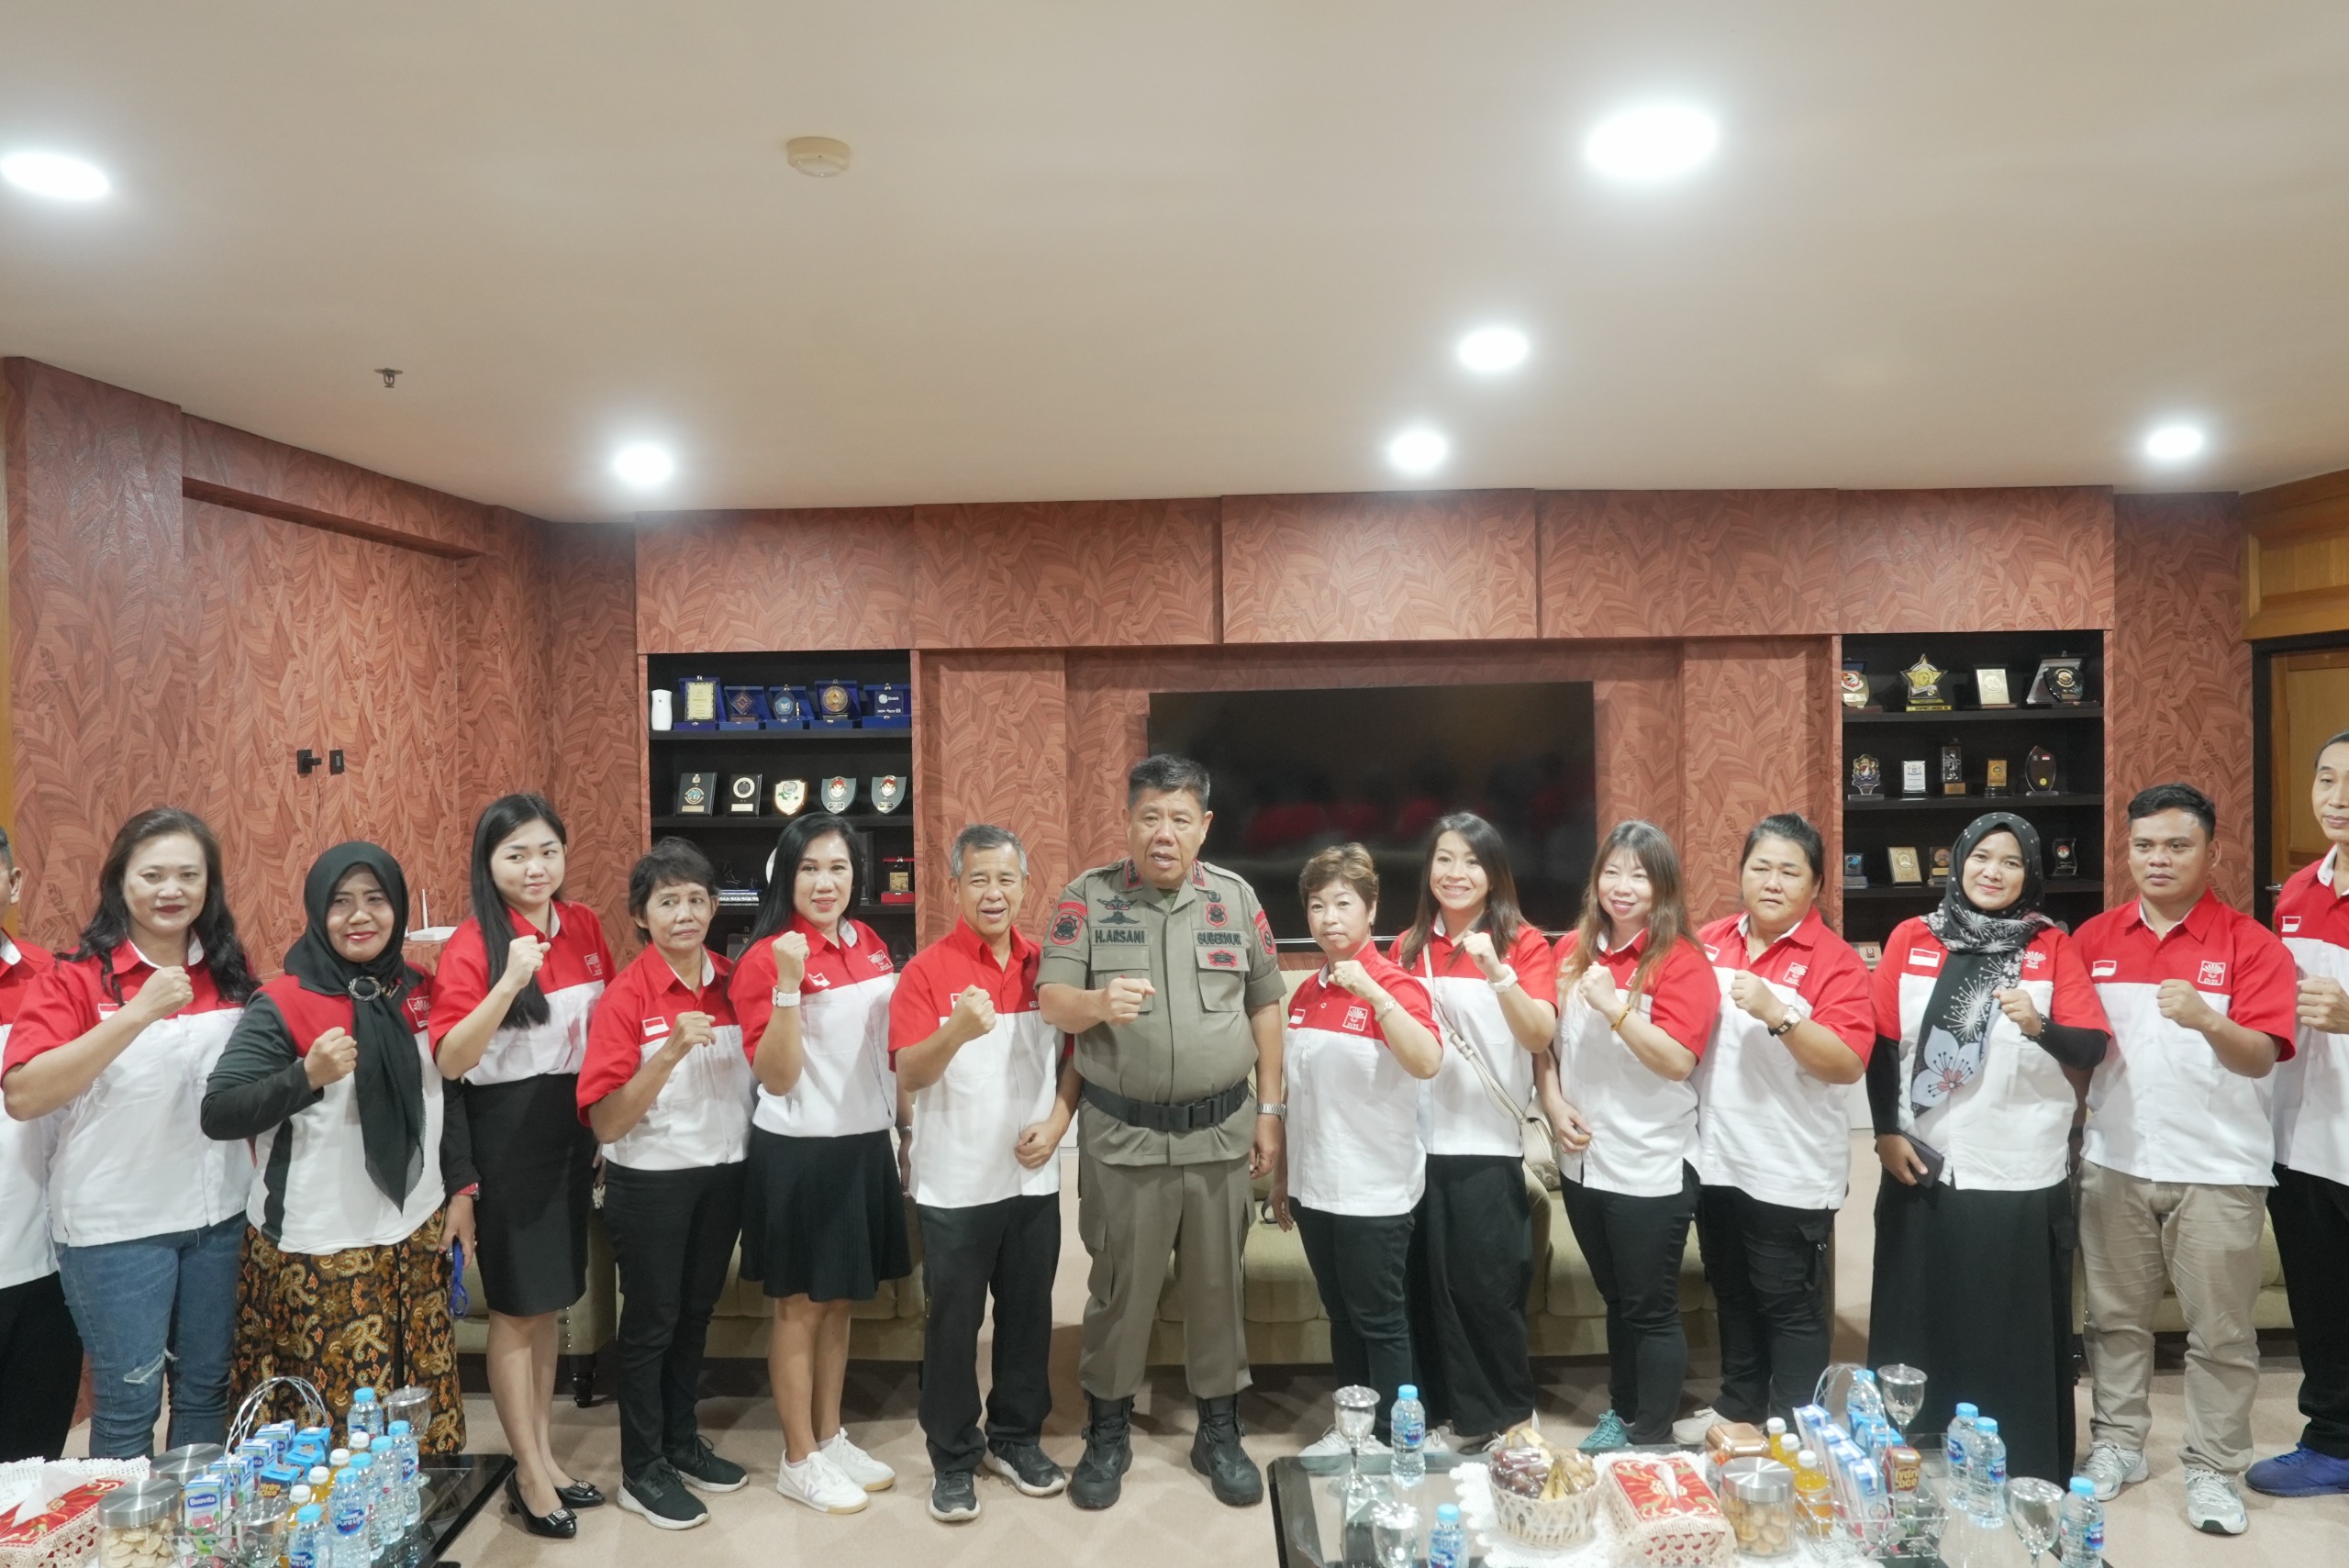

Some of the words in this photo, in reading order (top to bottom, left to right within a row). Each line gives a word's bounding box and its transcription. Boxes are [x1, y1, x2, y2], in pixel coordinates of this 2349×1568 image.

[1095, 929, 1145, 944] H.ARSANI
[1197, 931, 1241, 946] GUBERNUR
[260, 1483, 282, 1492] Hydro
[189, 1496, 216, 1506] Buavita
